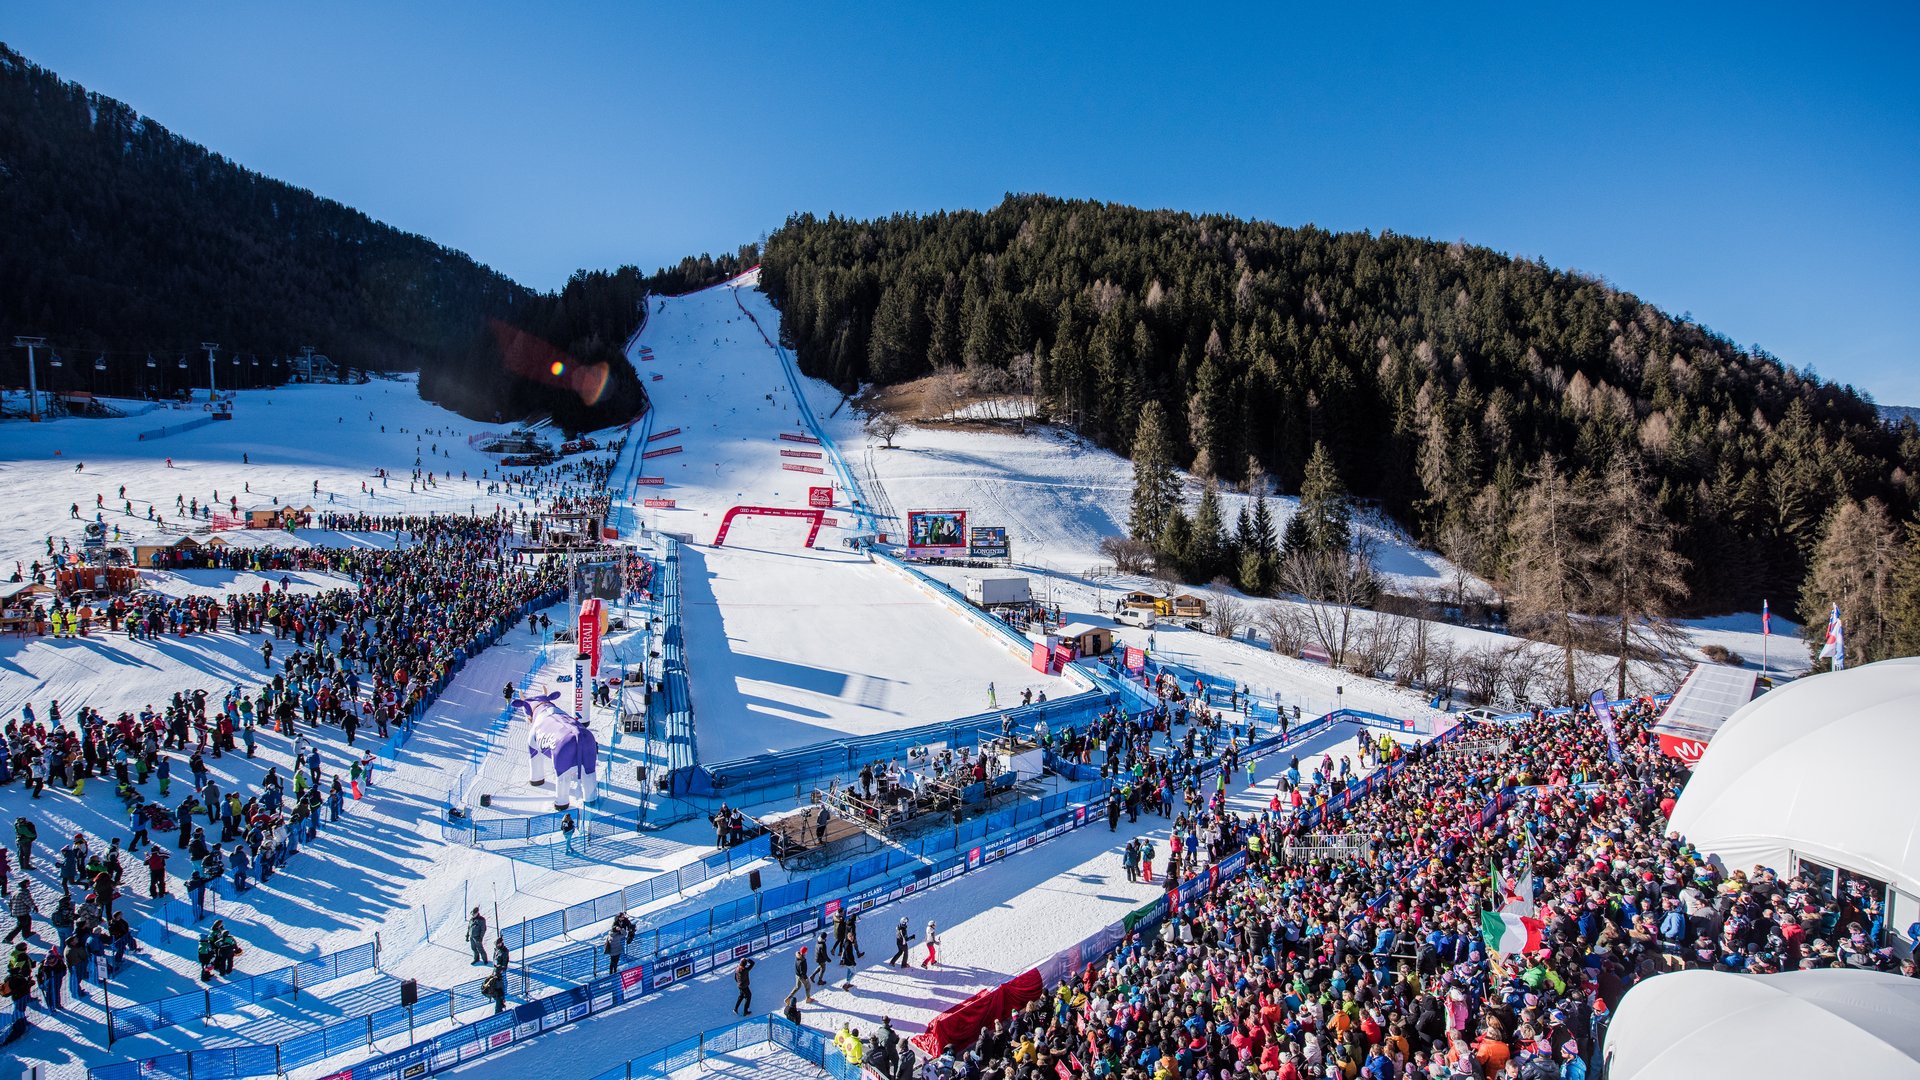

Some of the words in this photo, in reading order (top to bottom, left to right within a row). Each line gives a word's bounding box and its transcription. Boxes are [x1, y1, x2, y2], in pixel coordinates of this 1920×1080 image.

[581, 622, 593, 660] NERALI
[575, 664, 583, 712] INTERSPORT
[867, 887, 883, 897] CLASS
[1179, 878, 1209, 903] Kronplatz
[653, 957, 679, 970] WORLD
[680, 949, 703, 962] CLASS
[368, 1055, 407, 1073] WORLD
[408, 1041, 442, 1058] CLASS
